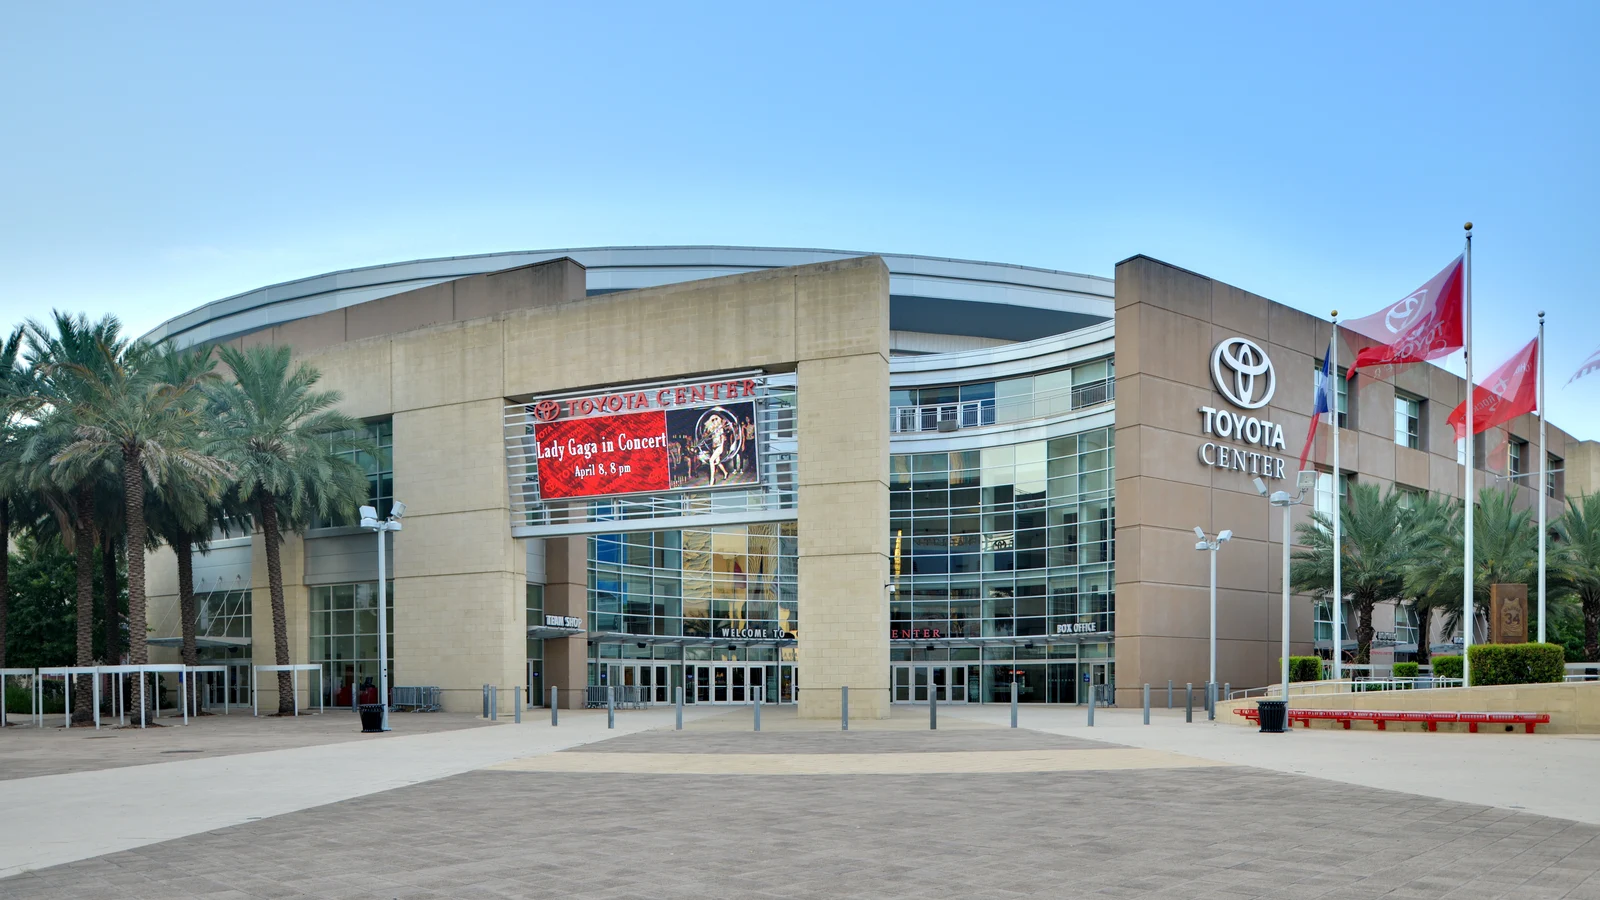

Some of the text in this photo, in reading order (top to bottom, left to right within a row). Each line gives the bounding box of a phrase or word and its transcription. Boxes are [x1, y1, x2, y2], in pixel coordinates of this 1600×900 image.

[566, 379, 756, 416] TOYOTA CENTER
[1198, 406, 1286, 450] TOYOTA
[536, 439, 565, 461] Lady
[568, 438, 598, 459] Gaga
[602, 436, 615, 453] in
[618, 432, 667, 451] Concert
[1199, 442, 1287, 479] CENTER
[574, 461, 632, 480] April 8, 8 pm
[545, 615, 583, 629] TEAM SHOP
[1056, 622, 1097, 634] BOX OFFICE
[1504, 612, 1520, 625] 34
[721, 628, 785, 638] WELCOME TO
